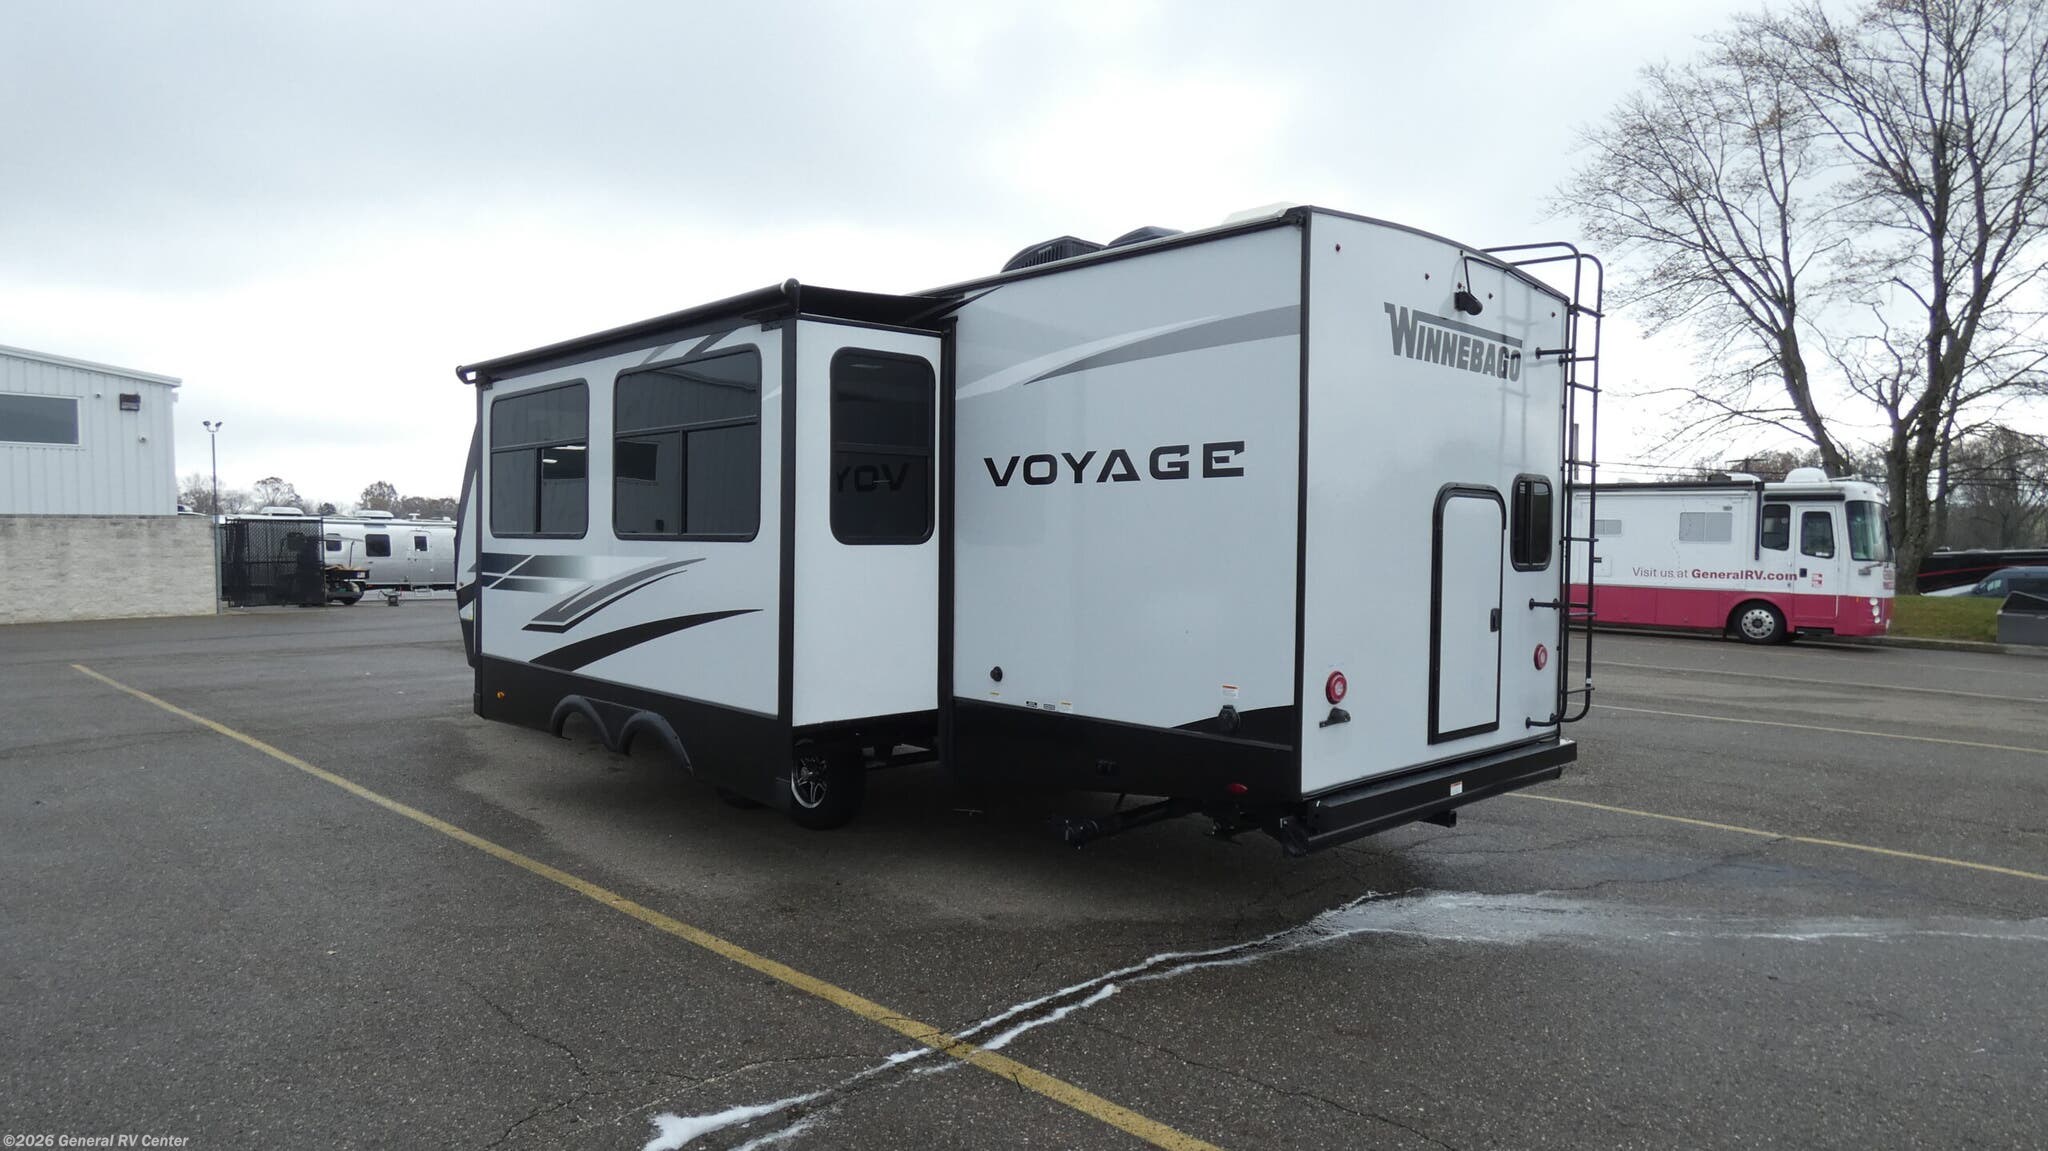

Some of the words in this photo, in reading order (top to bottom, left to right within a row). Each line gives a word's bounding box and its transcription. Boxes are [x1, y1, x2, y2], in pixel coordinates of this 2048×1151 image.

[1384, 302, 1523, 382] WINNEBAGO
[983, 440, 1245, 487] VOYAGE
[1632, 567, 1657, 578] Visit
[1660, 569, 1675, 578] us
[1677, 568, 1688, 579] at
[1691, 568, 1798, 582] GeneralRV.com
